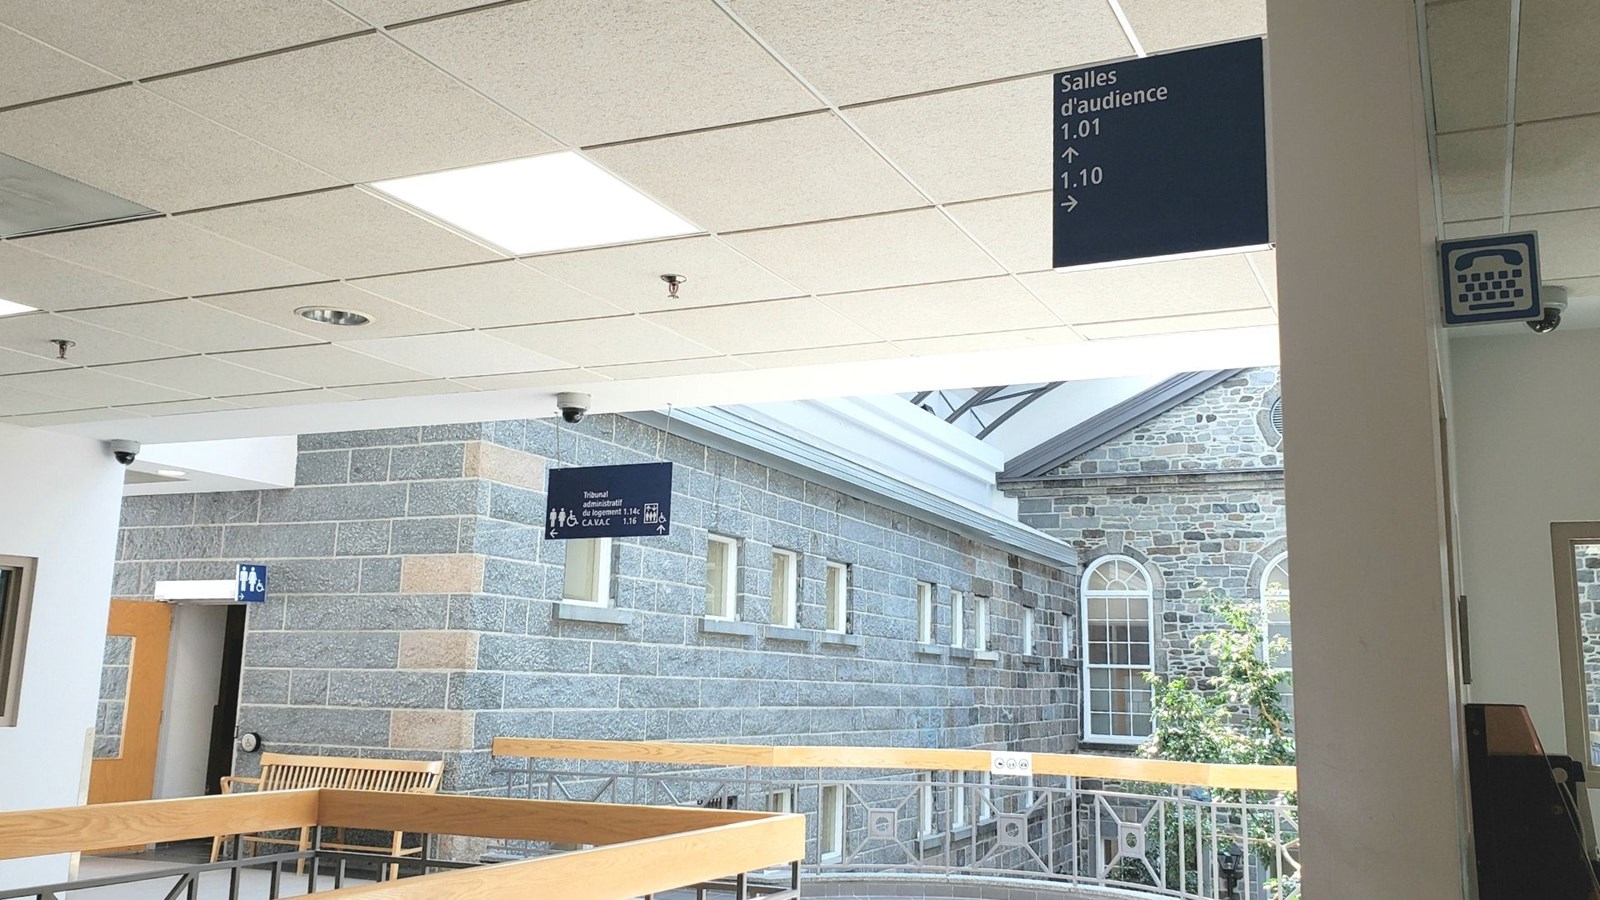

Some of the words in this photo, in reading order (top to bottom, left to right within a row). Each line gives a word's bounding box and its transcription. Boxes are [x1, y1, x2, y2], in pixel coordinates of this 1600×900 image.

[1061, 70, 1117, 93] Salles
[1061, 85, 1168, 117] d'audience
[1061, 118, 1100, 140] 1.01
[1061, 166, 1103, 189] 1.10
[583, 490, 609, 499] Tribunal
[582, 499, 623, 508] administratif
[582, 508, 591, 517] du
[591, 508, 622, 518] logement
[623, 516, 637, 525] 1.16
